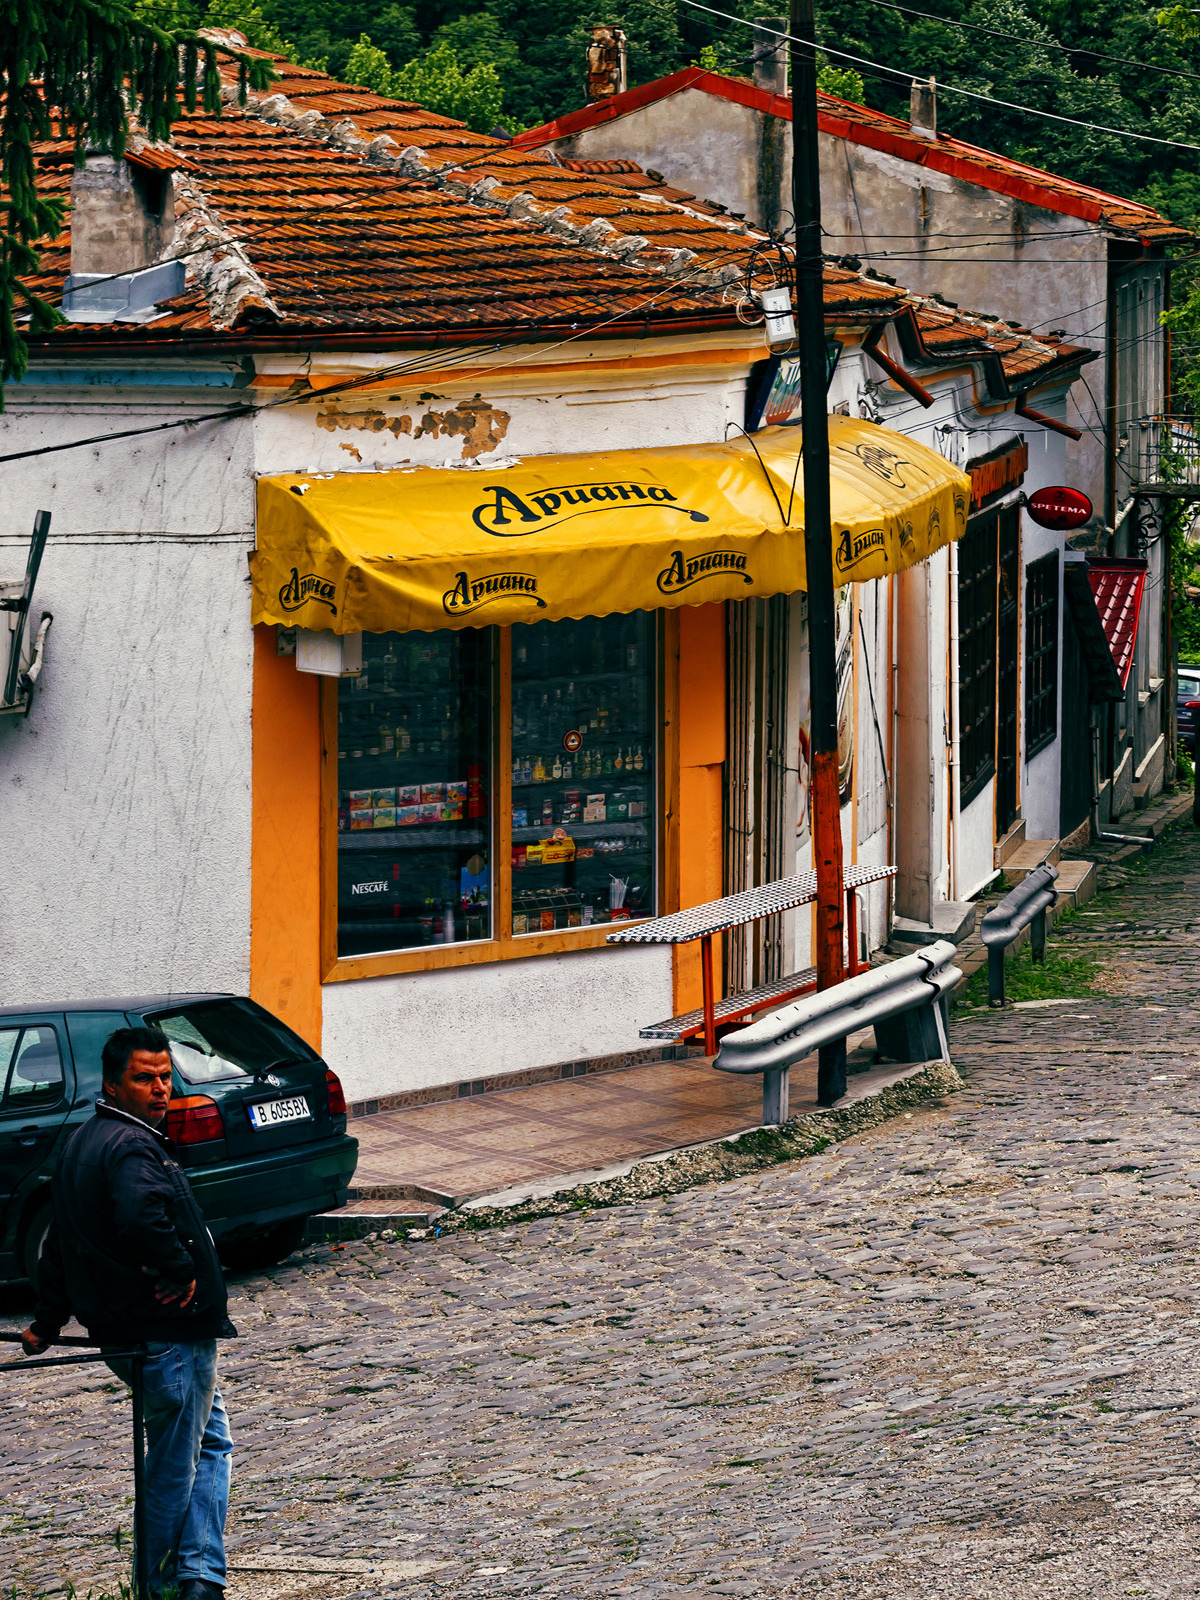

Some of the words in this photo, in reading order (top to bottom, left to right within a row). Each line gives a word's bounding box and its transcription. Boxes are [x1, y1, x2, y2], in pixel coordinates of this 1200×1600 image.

[472, 483, 690, 535] Ариана
[1031, 502, 1087, 515] SPETEMA
[836, 529, 887, 570] Ариан
[657, 550, 750, 593] Ариана
[442, 571, 543, 615] Ариана
[352, 881, 389, 895] NESCAFÉ
